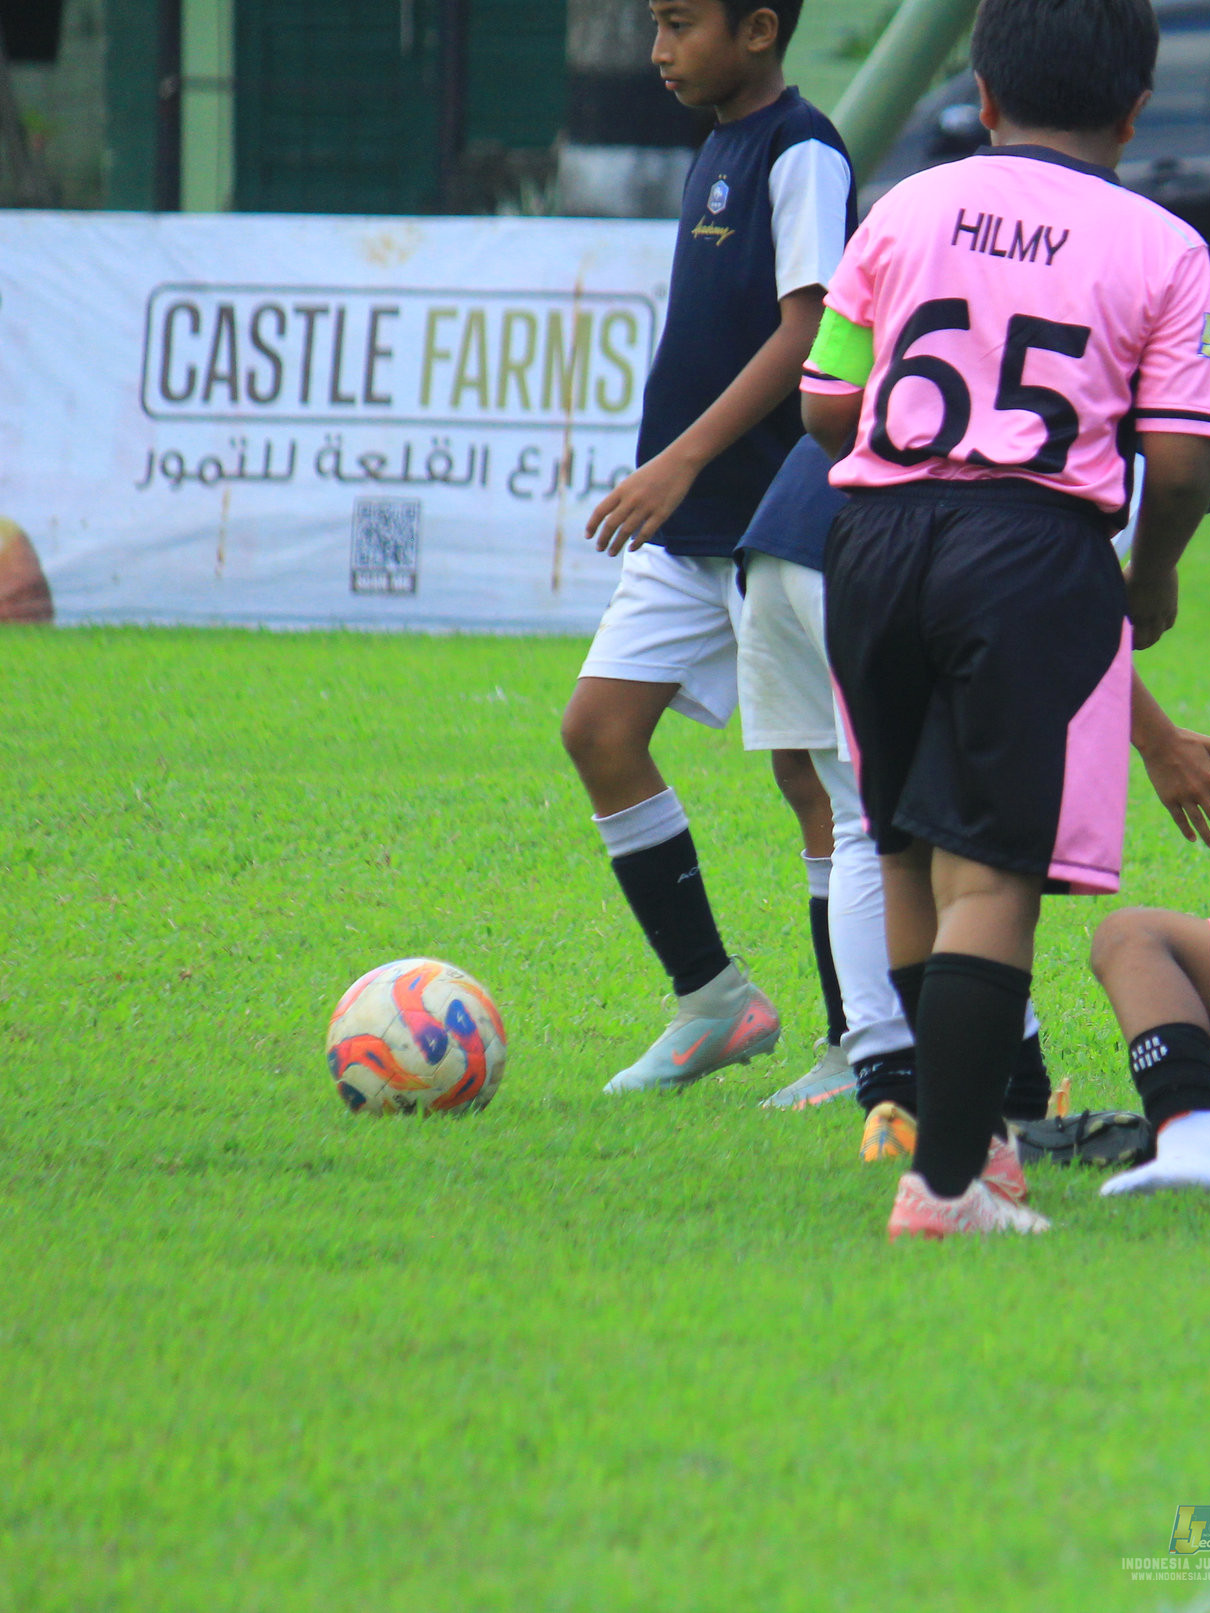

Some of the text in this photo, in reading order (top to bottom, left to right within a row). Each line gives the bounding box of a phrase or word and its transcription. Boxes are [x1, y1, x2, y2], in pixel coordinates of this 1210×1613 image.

[951, 207, 1070, 266] HILMY
[160, 301, 638, 413] CASTLE FARMS
[868, 297, 1092, 475] 65
[134, 435, 297, 492] للتمور
[315, 432, 490, 488] القلعة
